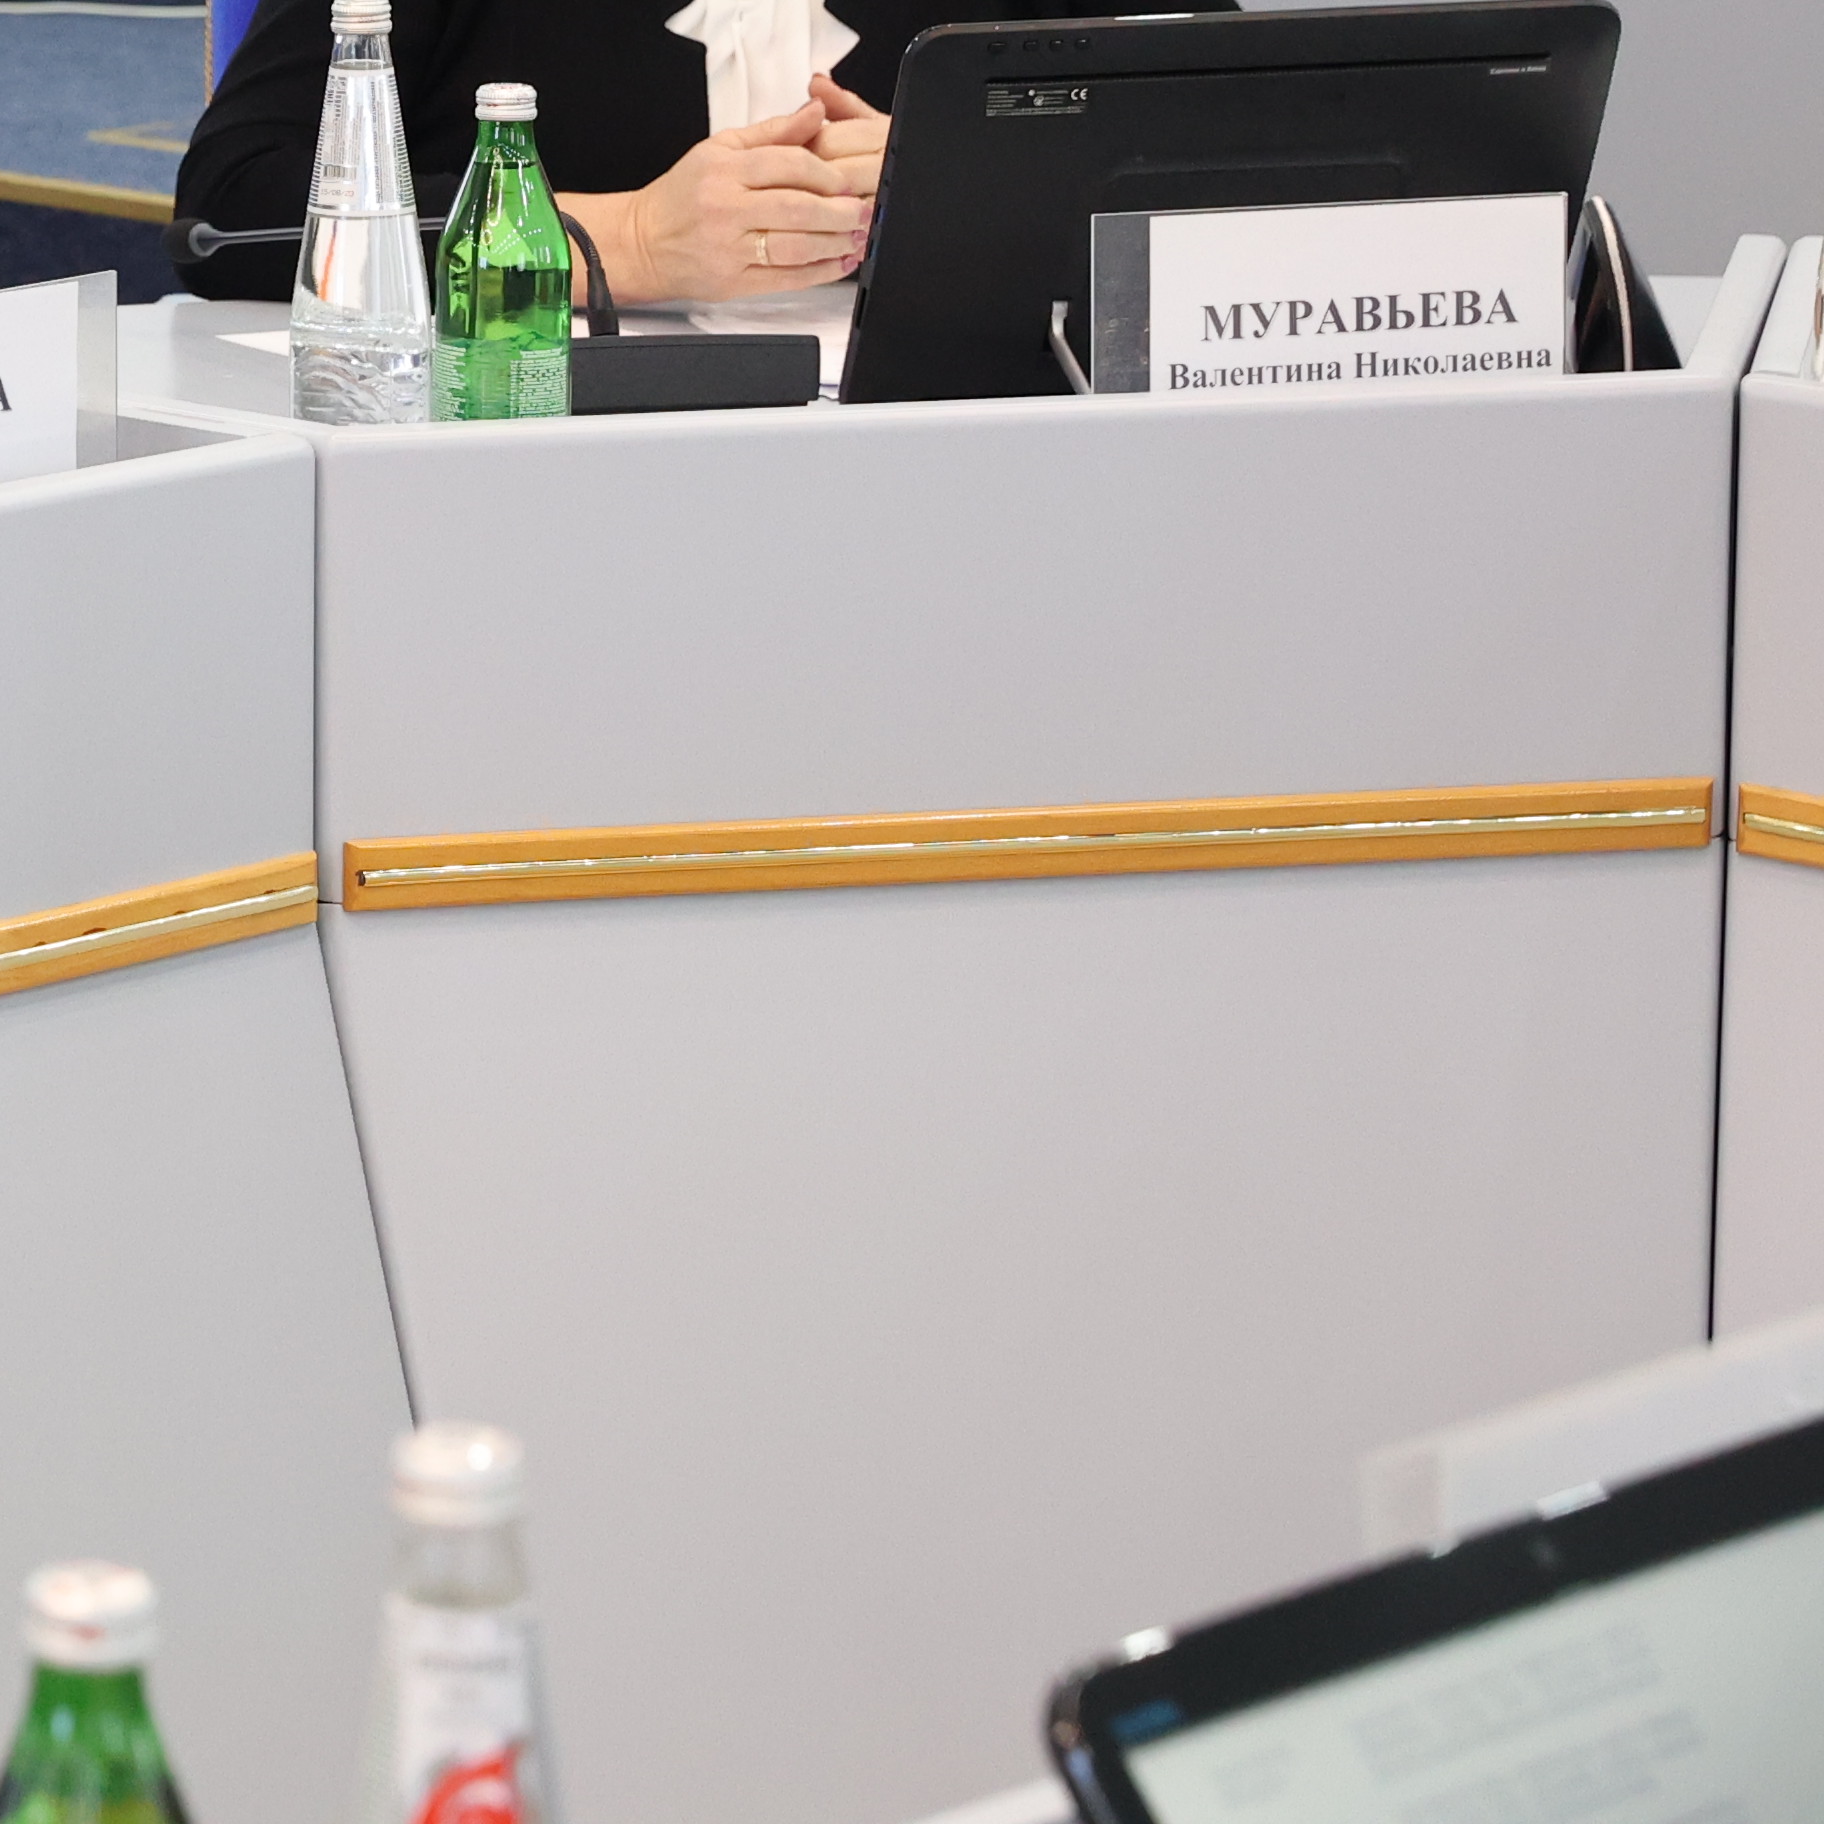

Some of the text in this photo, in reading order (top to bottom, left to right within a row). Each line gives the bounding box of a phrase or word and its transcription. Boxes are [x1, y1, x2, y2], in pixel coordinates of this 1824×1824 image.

[1200, 288, 1518, 342] МУРАВЬЕВА
[1168, 348, 1553, 391] Валентина Николаевна
